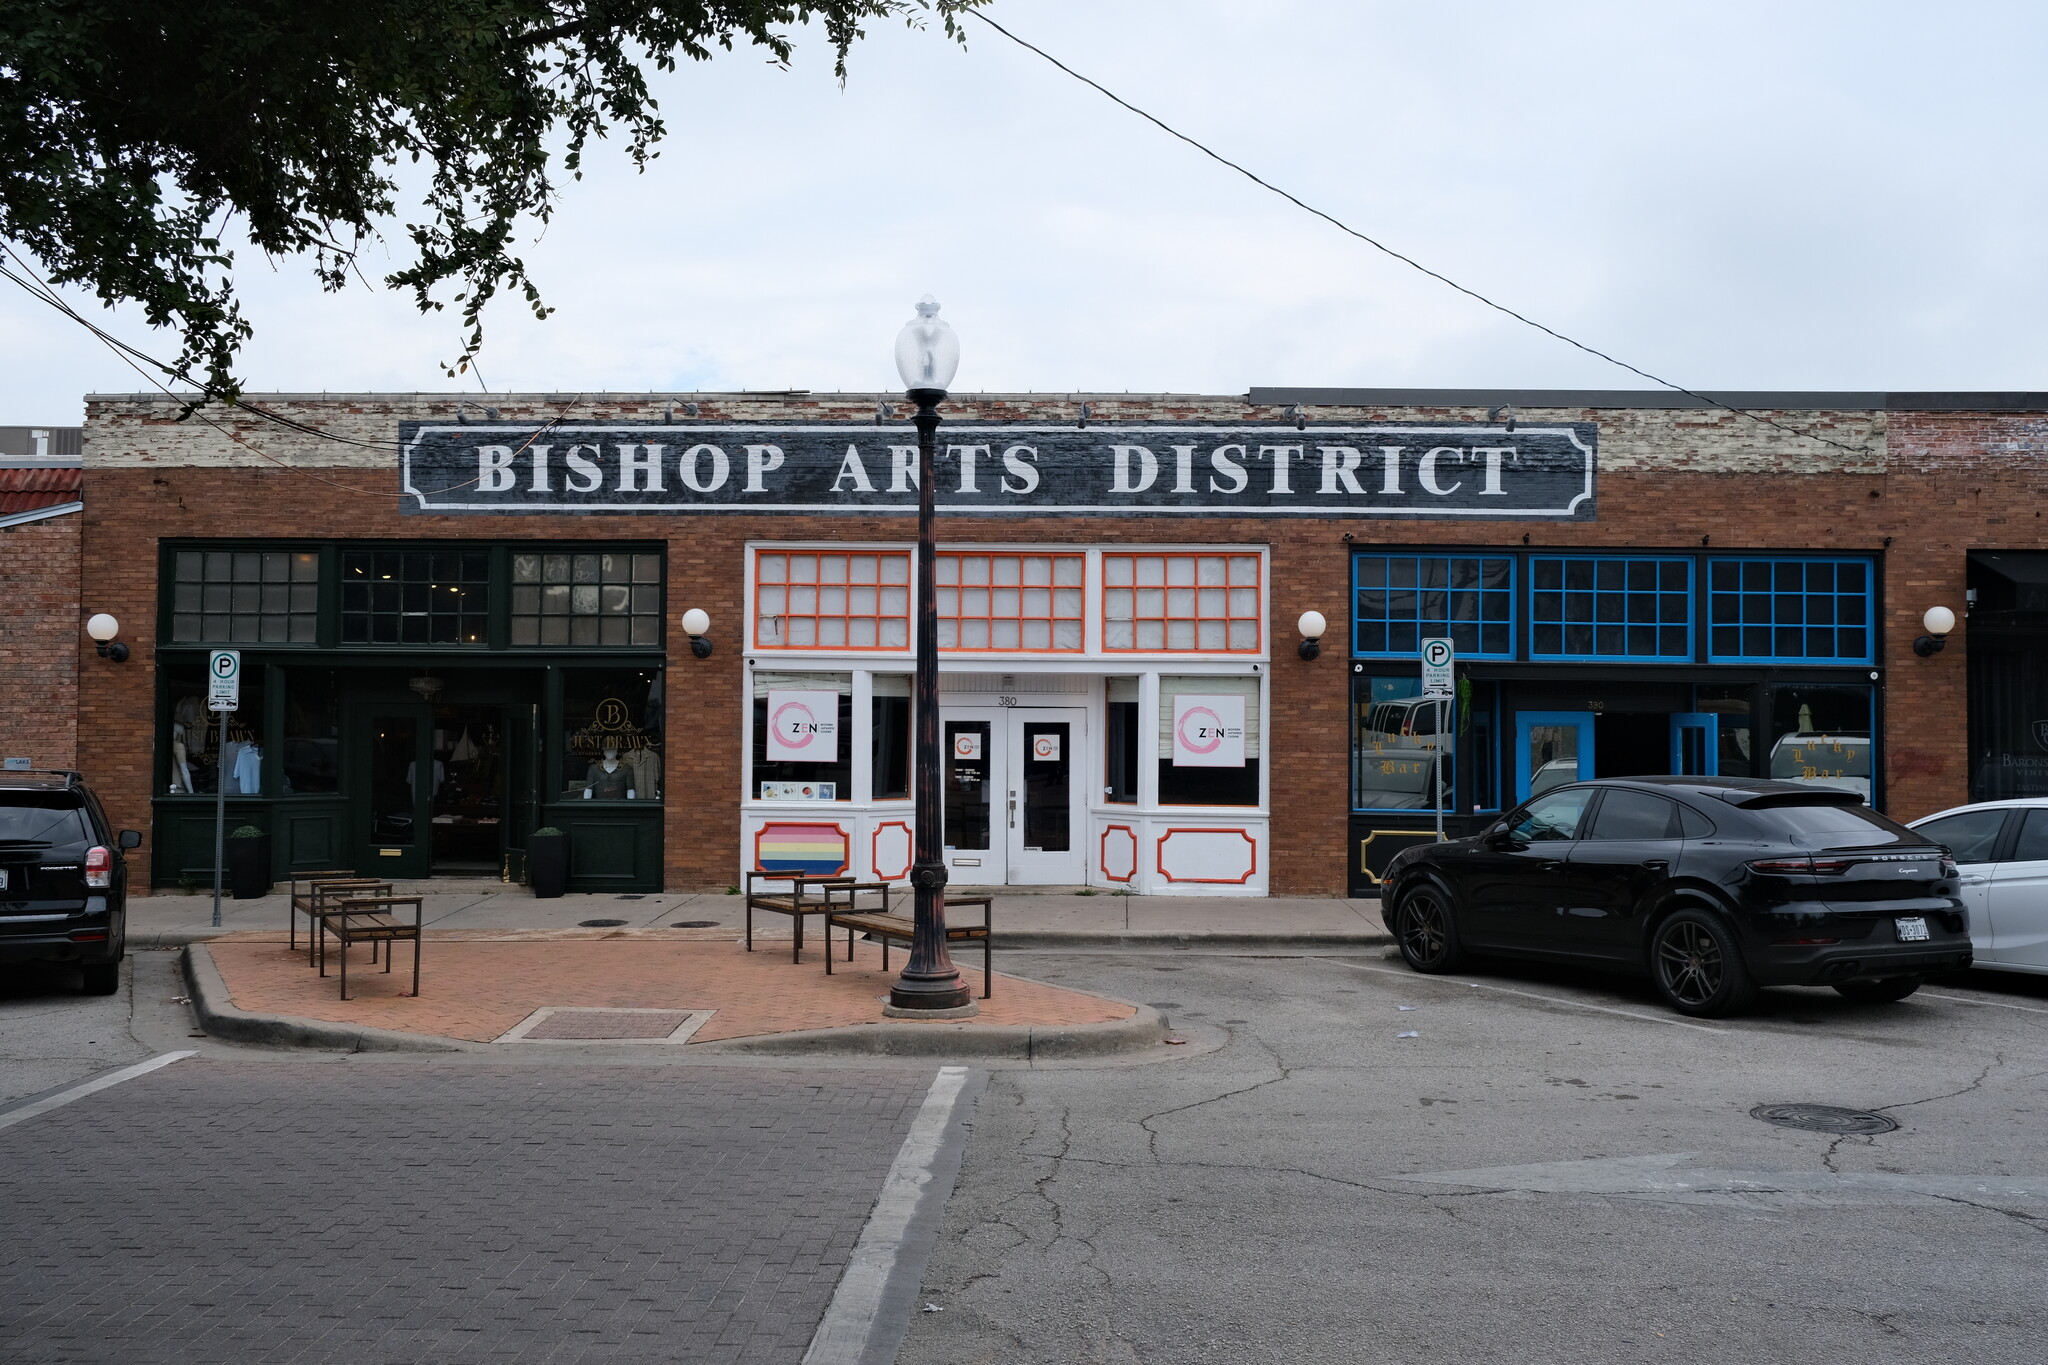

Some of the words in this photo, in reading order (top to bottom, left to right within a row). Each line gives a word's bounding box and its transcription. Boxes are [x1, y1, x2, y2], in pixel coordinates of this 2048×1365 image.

[473, 443, 786, 494] BISHOP
[829, 444, 1040, 494] ARTS
[1107, 443, 1518, 497] DISTRICT
[1432, 645, 1445, 662] P
[219, 658, 231, 673] P
[998, 696, 1017, 706] 380
[1588, 701, 1604, 709] 390
[792, 723, 817, 733] ZEN
[1199, 728, 1225, 738] ZEN
[571, 735, 602, 749] JUST
[1792, 734, 1857, 763] Lucky
[1380, 760, 1420, 776] Bar
[1802, 766, 1844, 781] Bar
